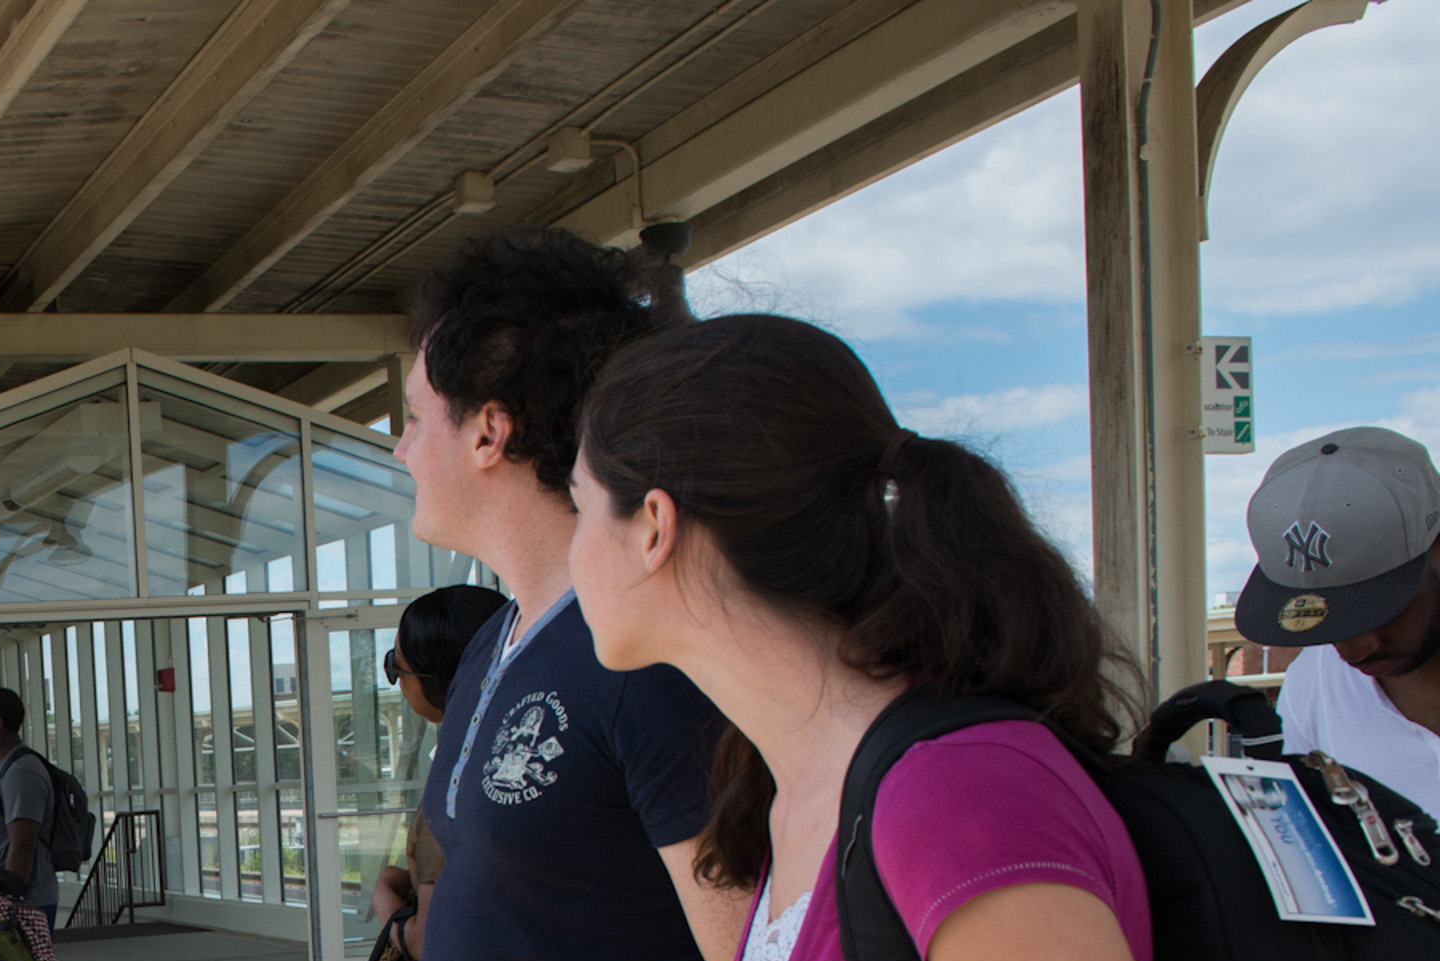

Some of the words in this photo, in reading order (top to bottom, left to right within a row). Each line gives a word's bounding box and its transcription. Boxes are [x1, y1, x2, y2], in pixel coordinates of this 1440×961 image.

[1204, 402, 1233, 411] scalator
[1207, 427, 1216, 436] To
[1216, 427, 1233, 436] Stair
[1282, 520, 1333, 572] NY
[522, 786, 543, 801] CO.
